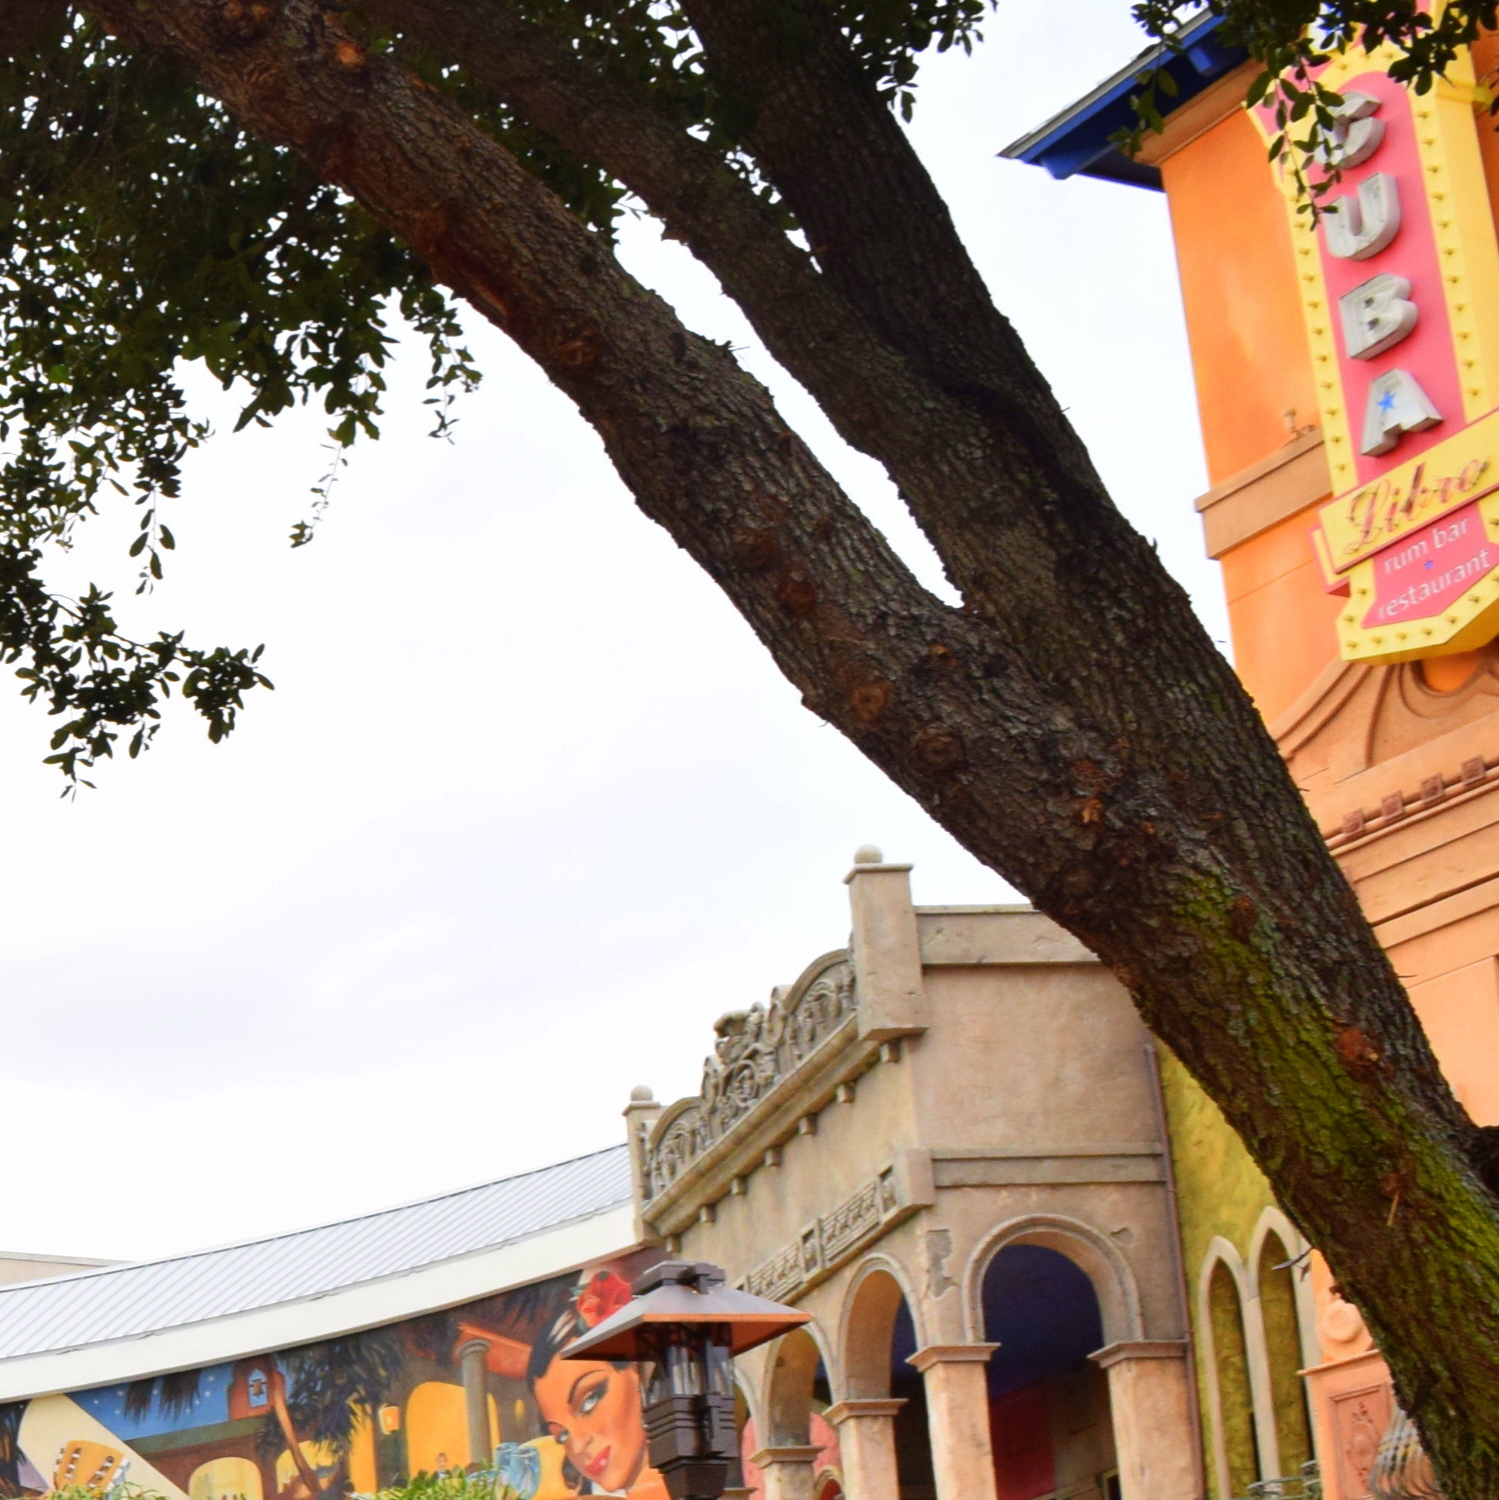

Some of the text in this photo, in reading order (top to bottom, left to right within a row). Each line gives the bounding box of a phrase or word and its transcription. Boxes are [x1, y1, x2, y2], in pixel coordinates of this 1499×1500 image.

[1315, 91, 1443, 457] CUBA
[1344, 456, 1490, 554] Libre
[1384, 517, 1468, 575] rum bar
[1378, 549, 1491, 619] restaurant
